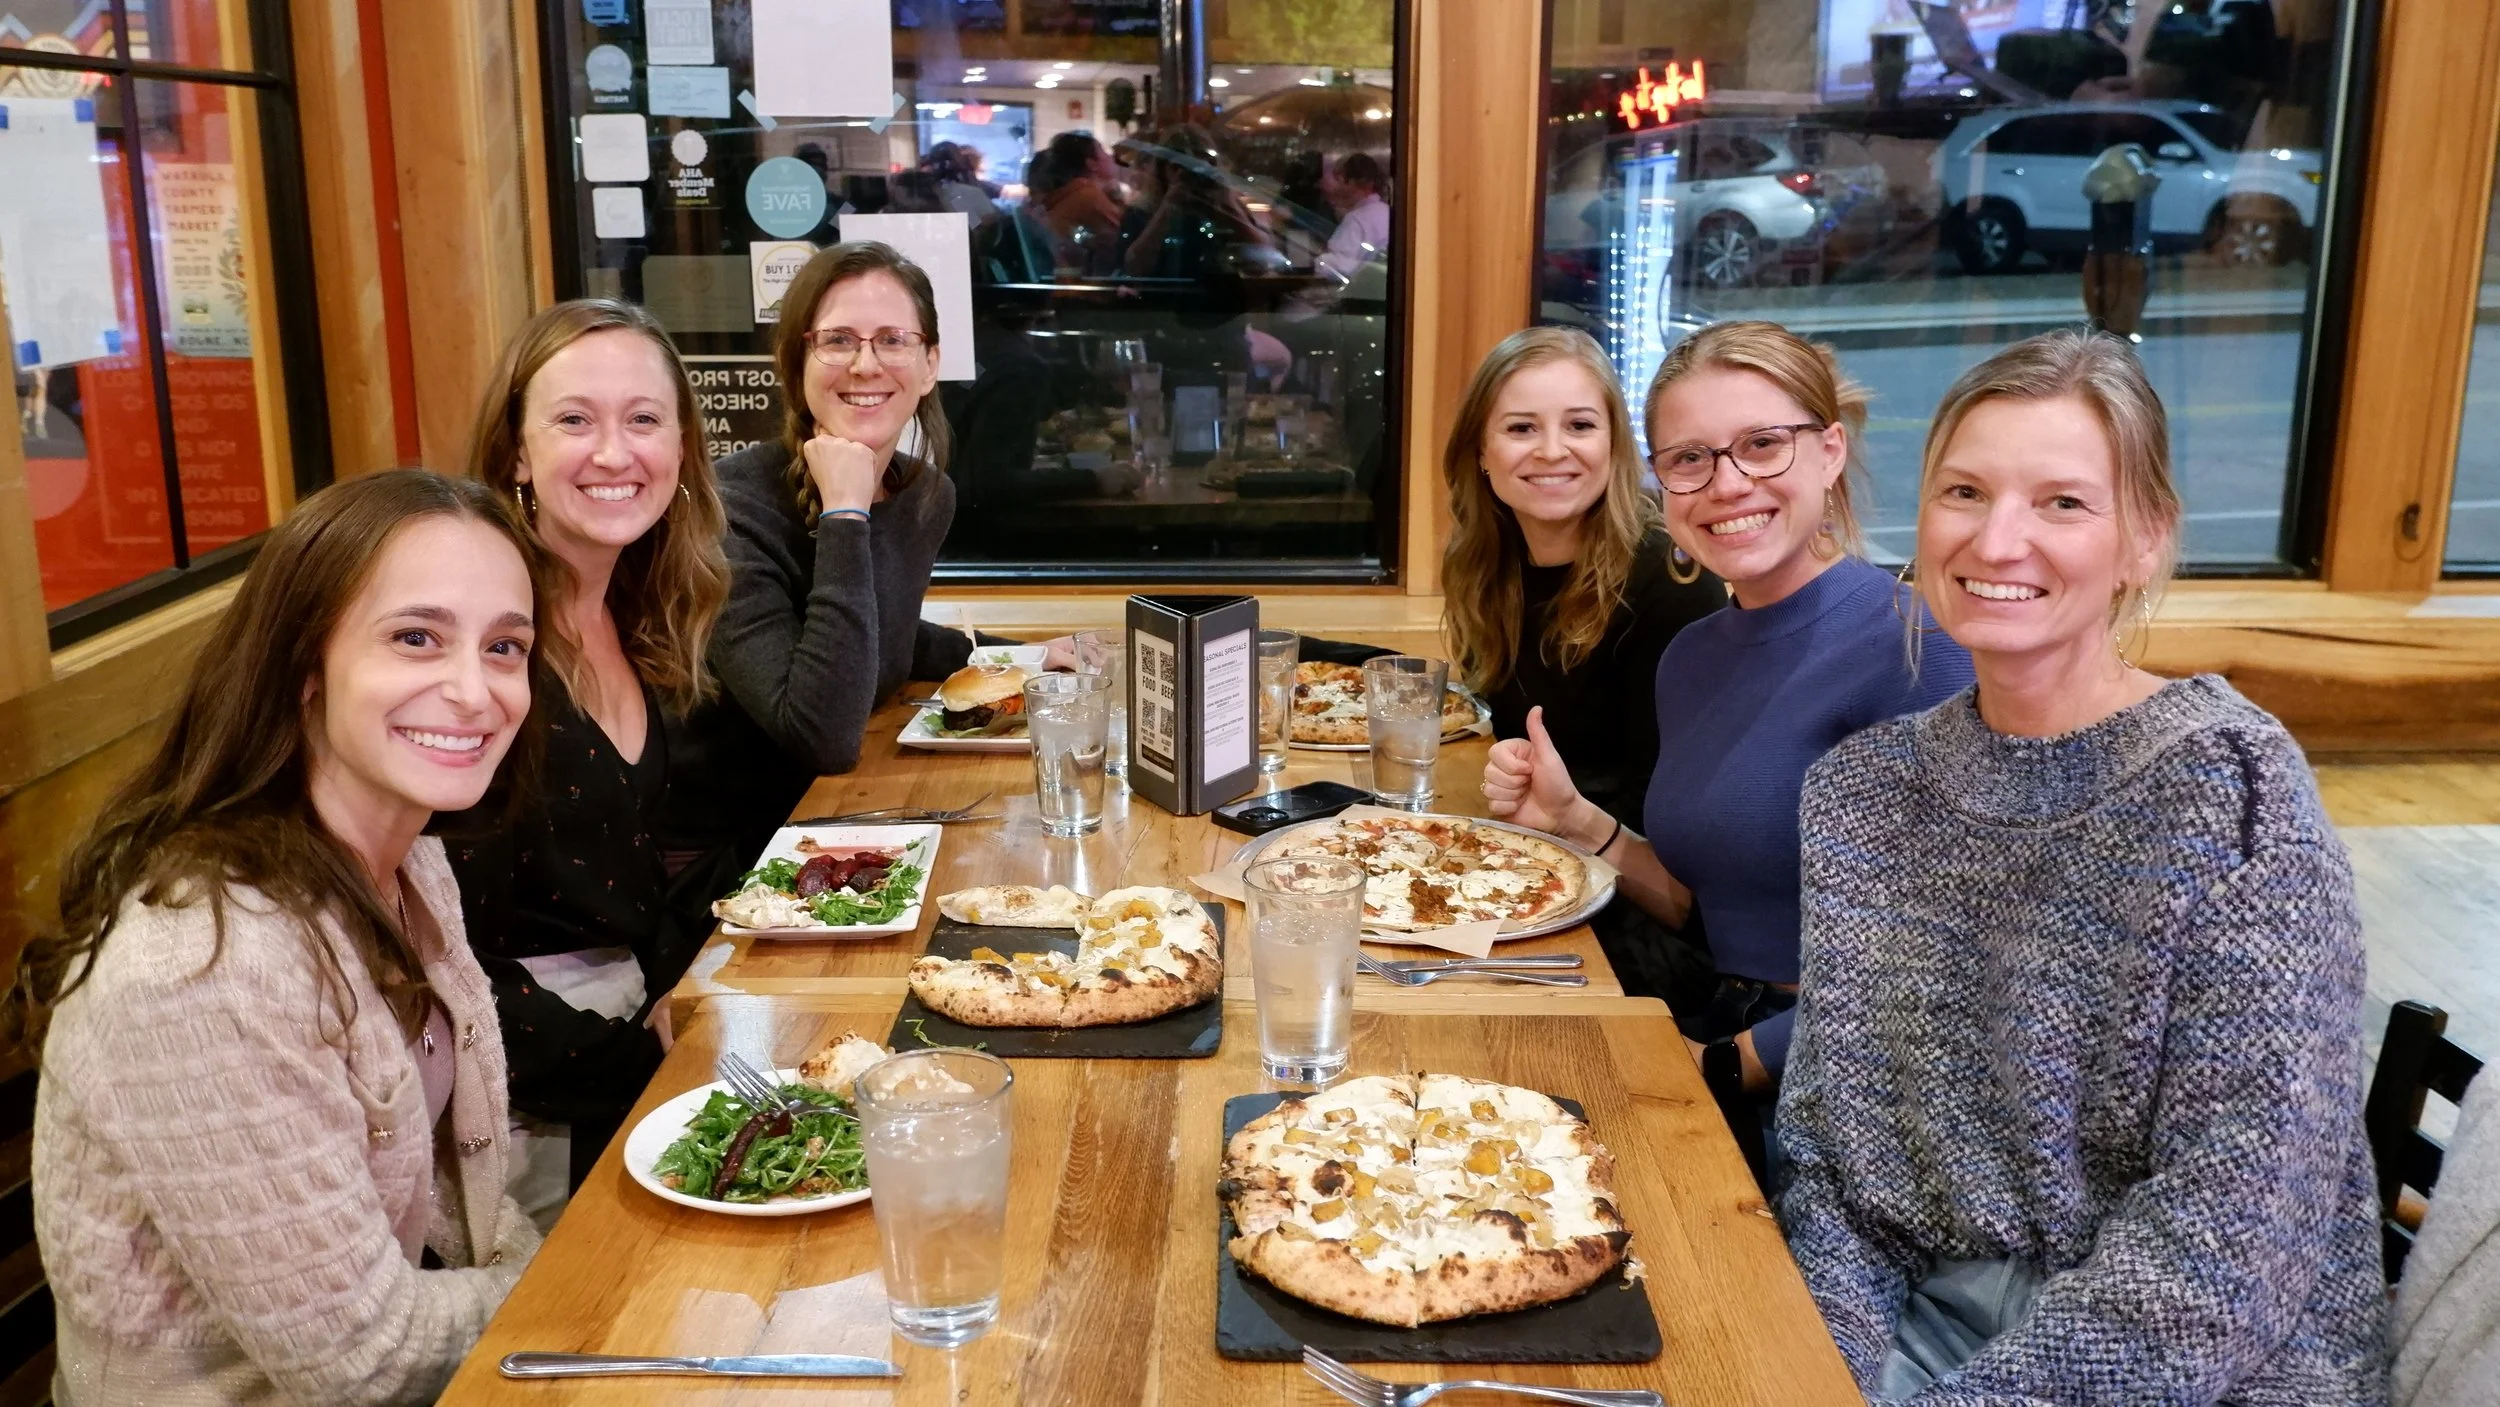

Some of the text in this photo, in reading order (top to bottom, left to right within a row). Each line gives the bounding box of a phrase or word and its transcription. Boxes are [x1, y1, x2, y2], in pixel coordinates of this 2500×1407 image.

[765, 265, 784, 274] BUY
[1203, 642, 1247, 663] EASONAL SPECIALS
[1142, 675, 1156, 692] FOOD
